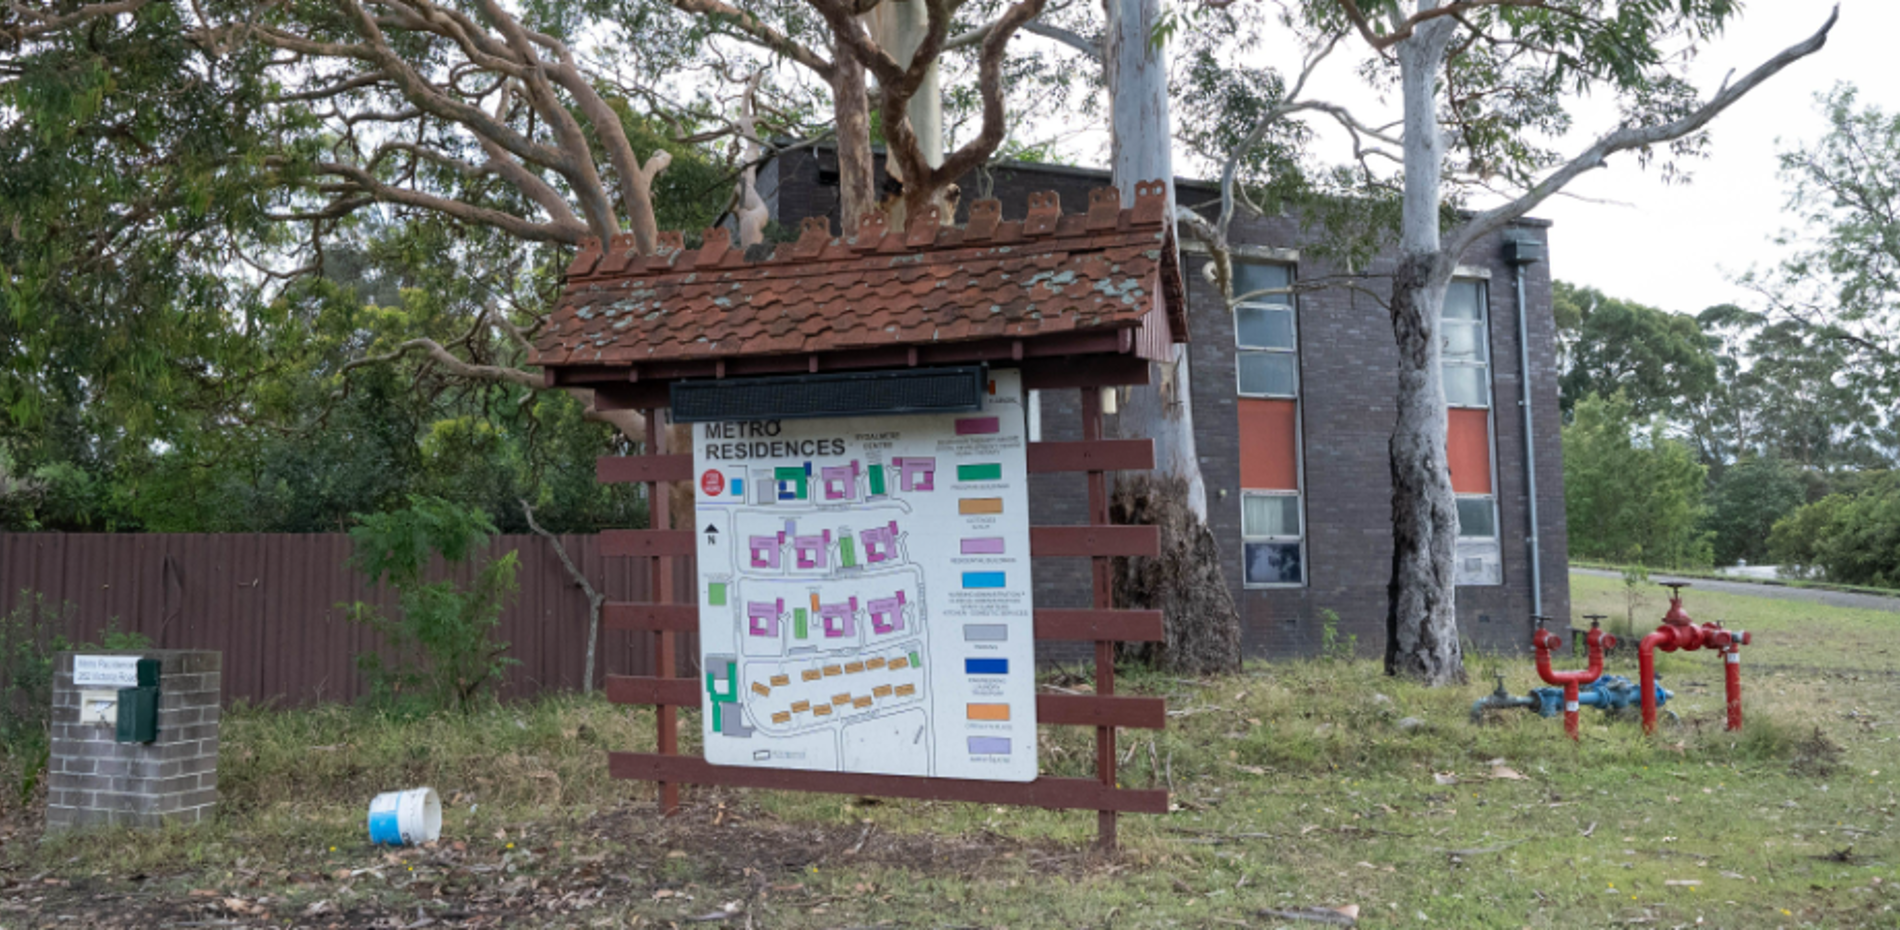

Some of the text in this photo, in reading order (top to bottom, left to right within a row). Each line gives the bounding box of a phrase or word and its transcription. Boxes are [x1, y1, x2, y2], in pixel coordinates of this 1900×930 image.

[705, 420, 782, 439] METRO
[706, 439, 845, 460] RESIDENCES
[707, 534, 716, 545] N
